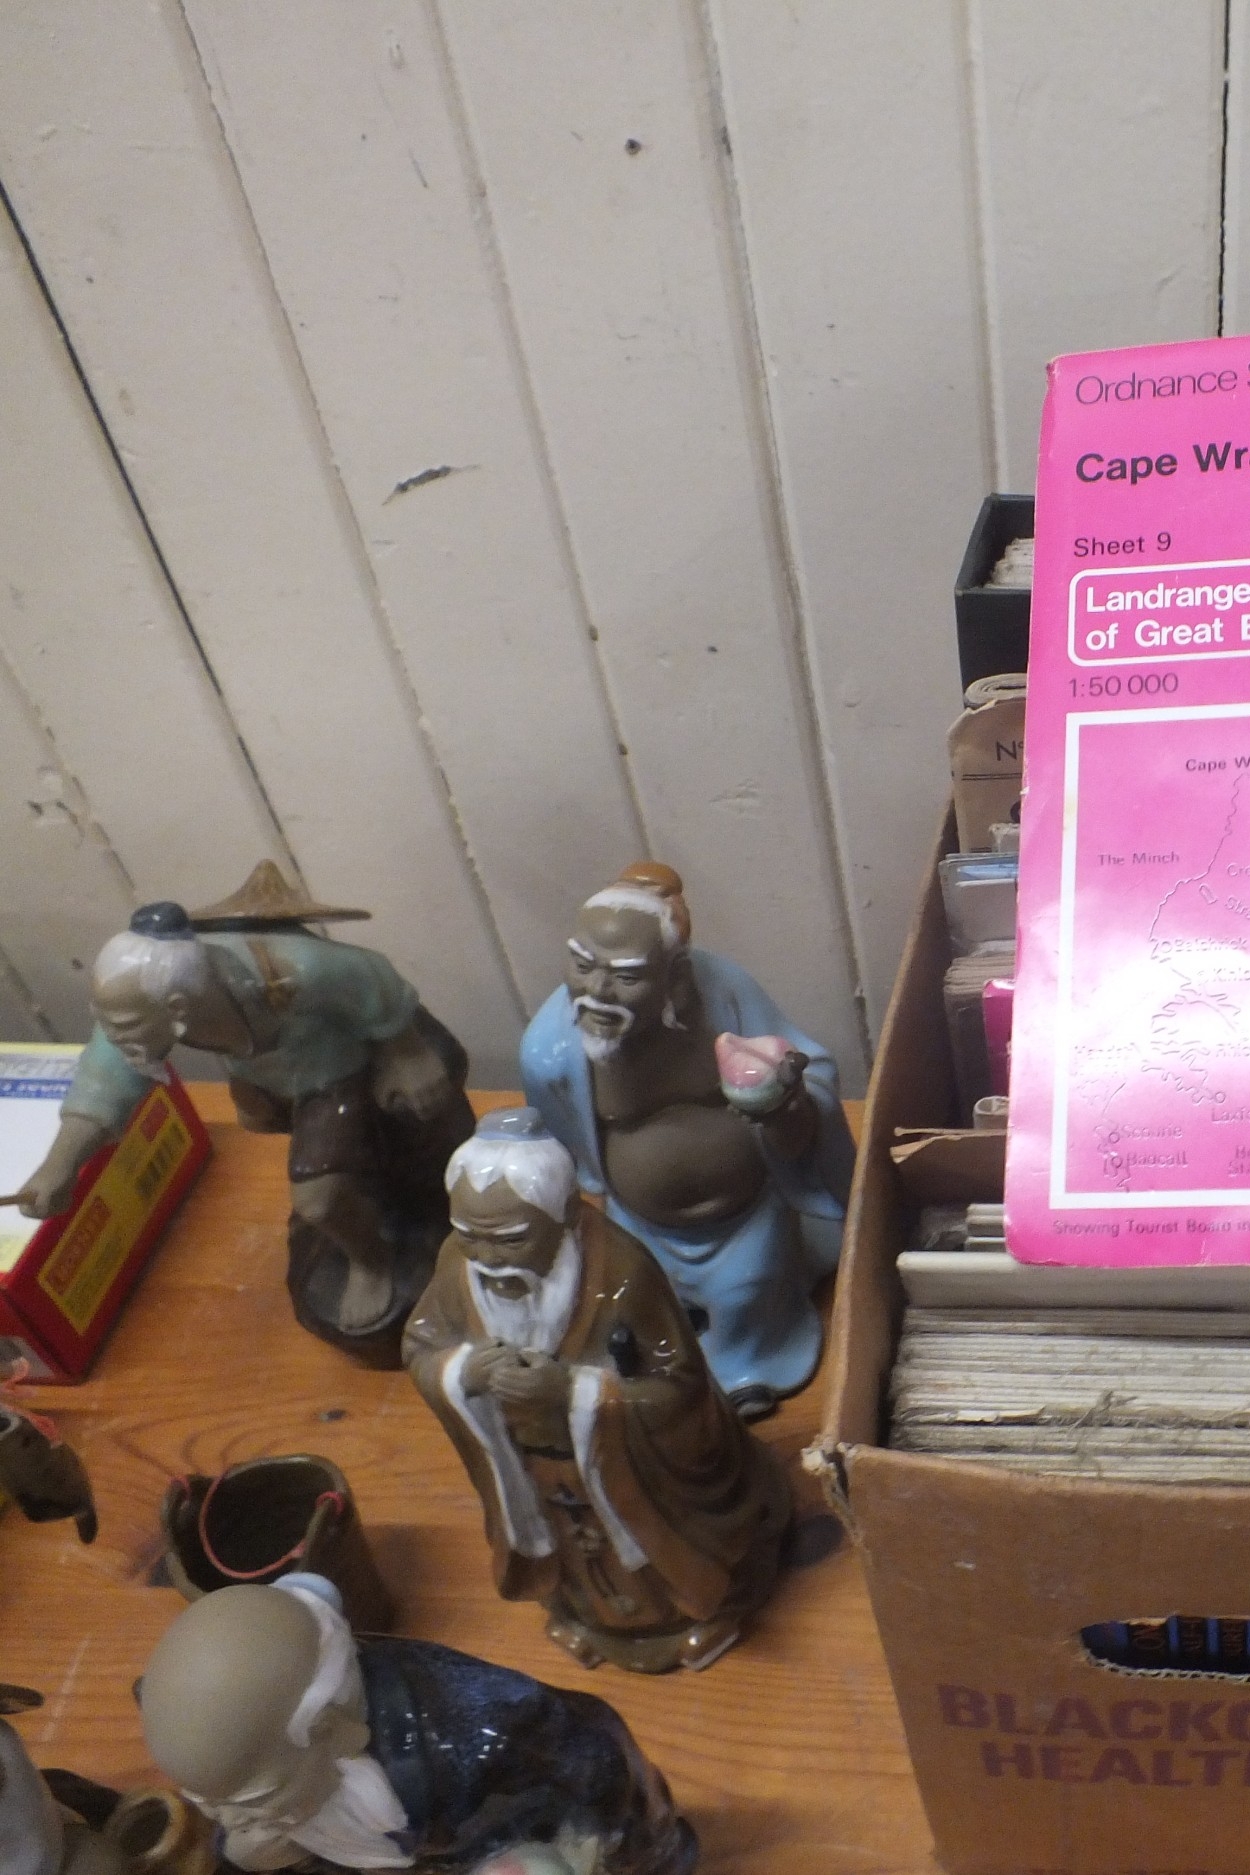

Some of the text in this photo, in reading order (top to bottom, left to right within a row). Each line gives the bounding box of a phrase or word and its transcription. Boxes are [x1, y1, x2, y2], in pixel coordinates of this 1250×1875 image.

[1076, 366, 1237, 405] Ordnance
[1076, 448, 1178, 485] Cape
[1073, 532, 1172, 558] Sheet 9
[1085, 622, 1119, 651] of
[1134, 615, 1223, 648] Great
[1185, 758, 1226, 774] Cape
[1098, 850, 1180, 867] The Minch
[1053, 1220, 1120, 1238] Showing
[1127, 1218, 1179, 1234] Tourist
[1186, 1217, 1232, 1232] Board
